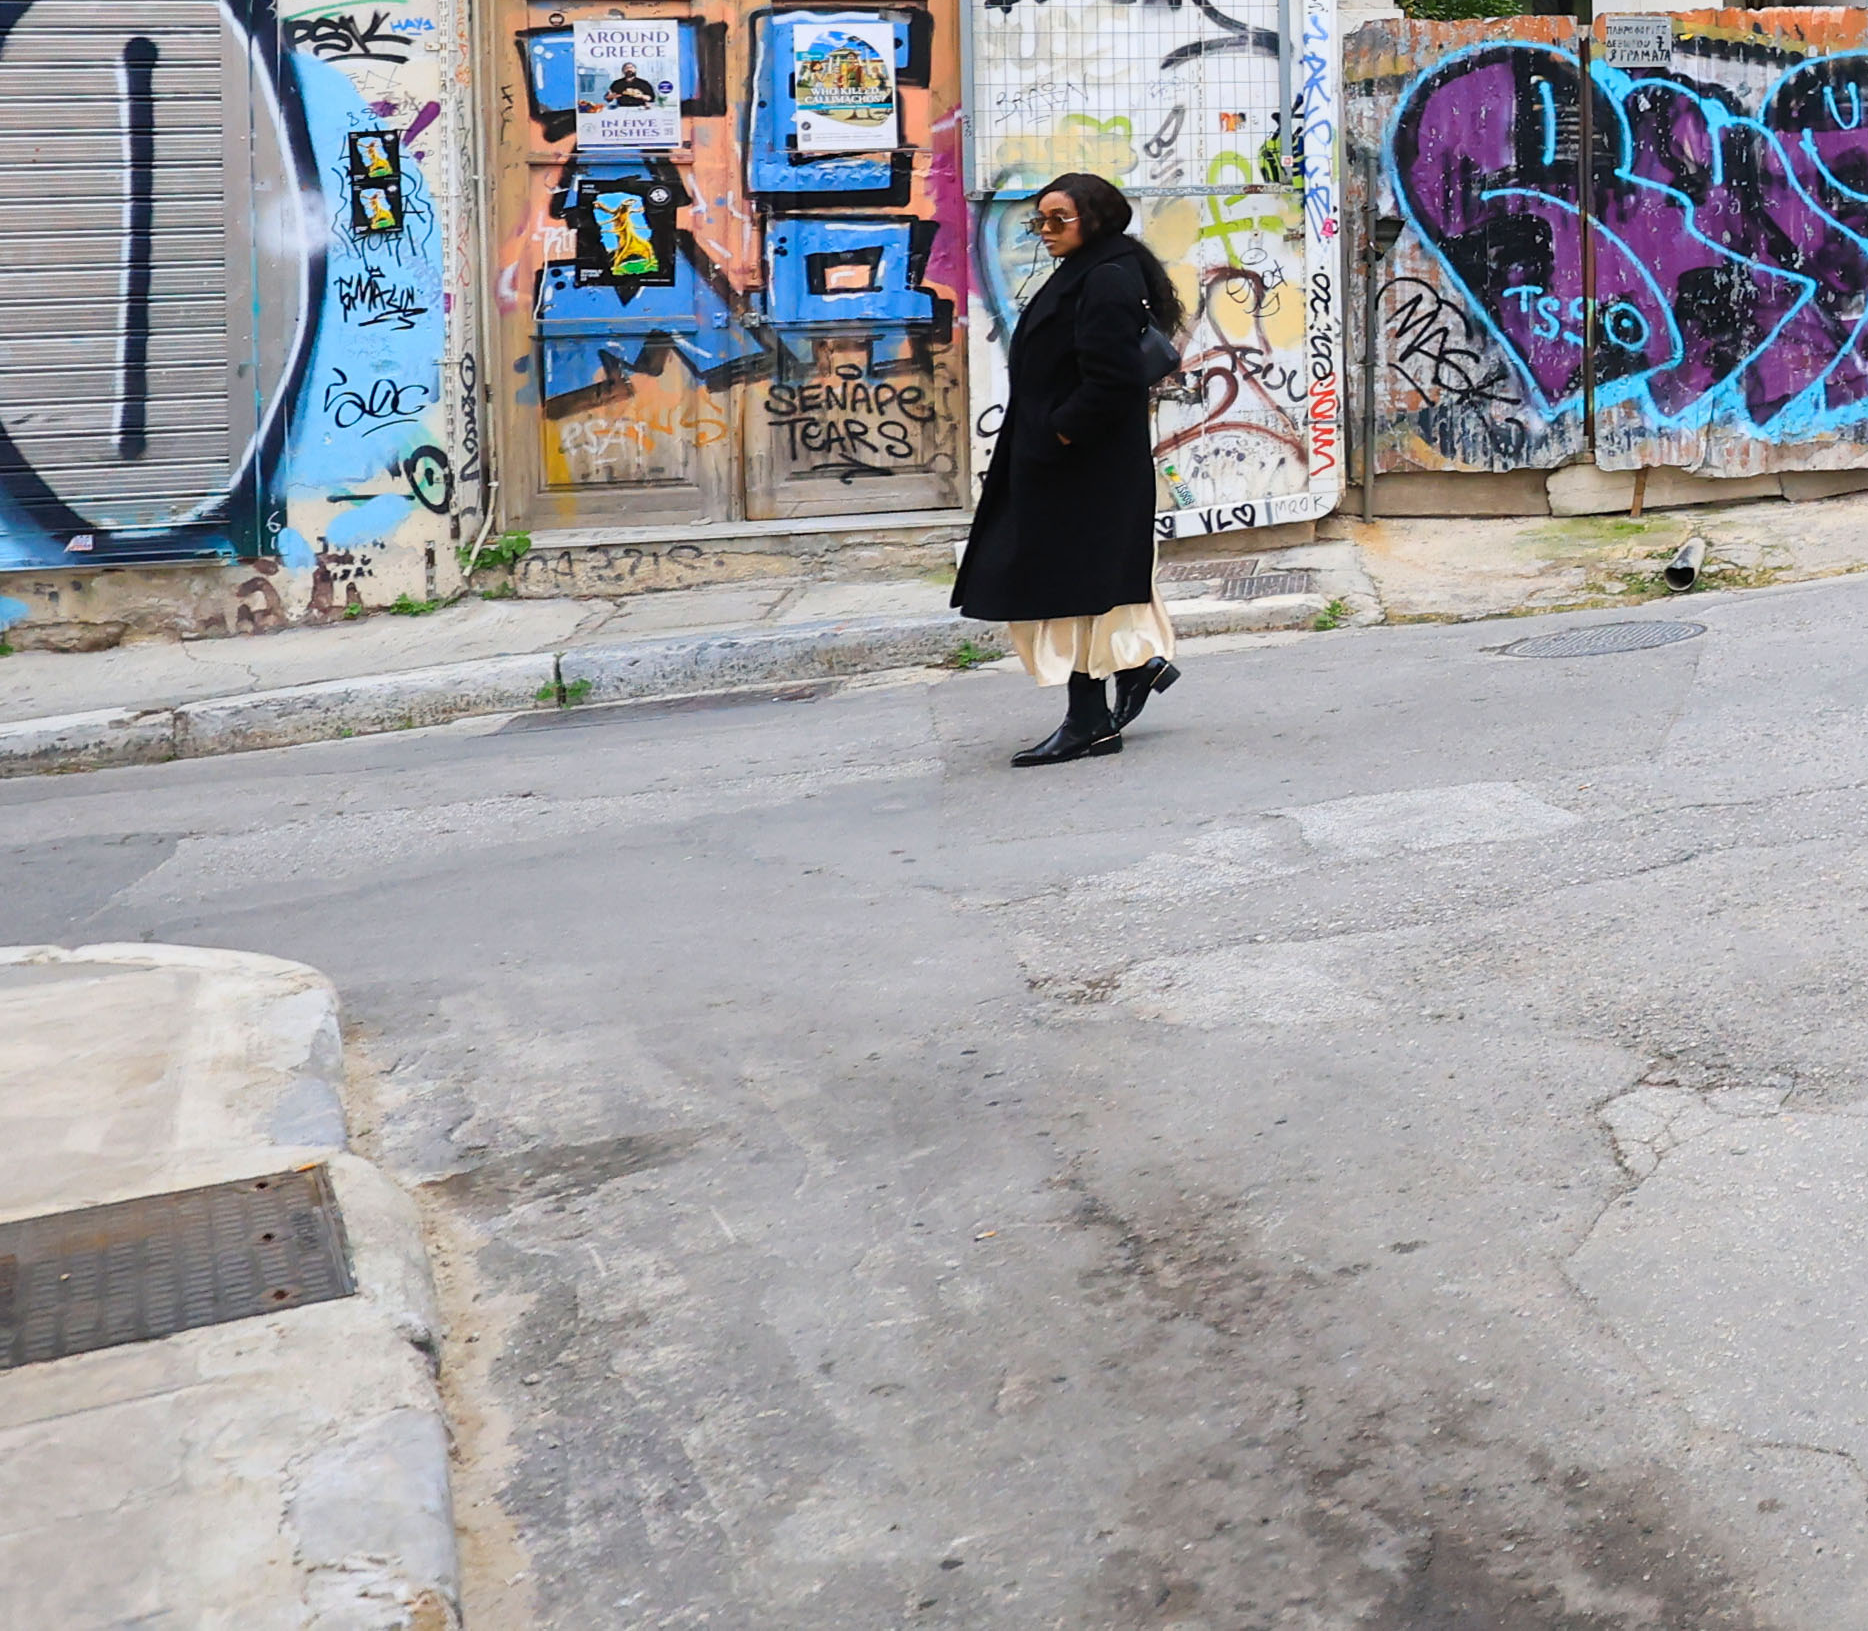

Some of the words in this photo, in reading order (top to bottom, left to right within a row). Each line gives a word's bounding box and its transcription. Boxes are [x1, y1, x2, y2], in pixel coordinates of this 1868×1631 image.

[584, 31, 670, 43] AROUND
[590, 46, 666, 58] GREECE
[1620, 49, 1671, 62] ΓΡΑΜΑΤΑ
[811, 87, 837, 96] WHO
[840, 86, 879, 95] KILLED
[601, 119, 618, 128] IN
[623, 118, 657, 127] FIVE
[601, 129, 660, 138] DISHES
